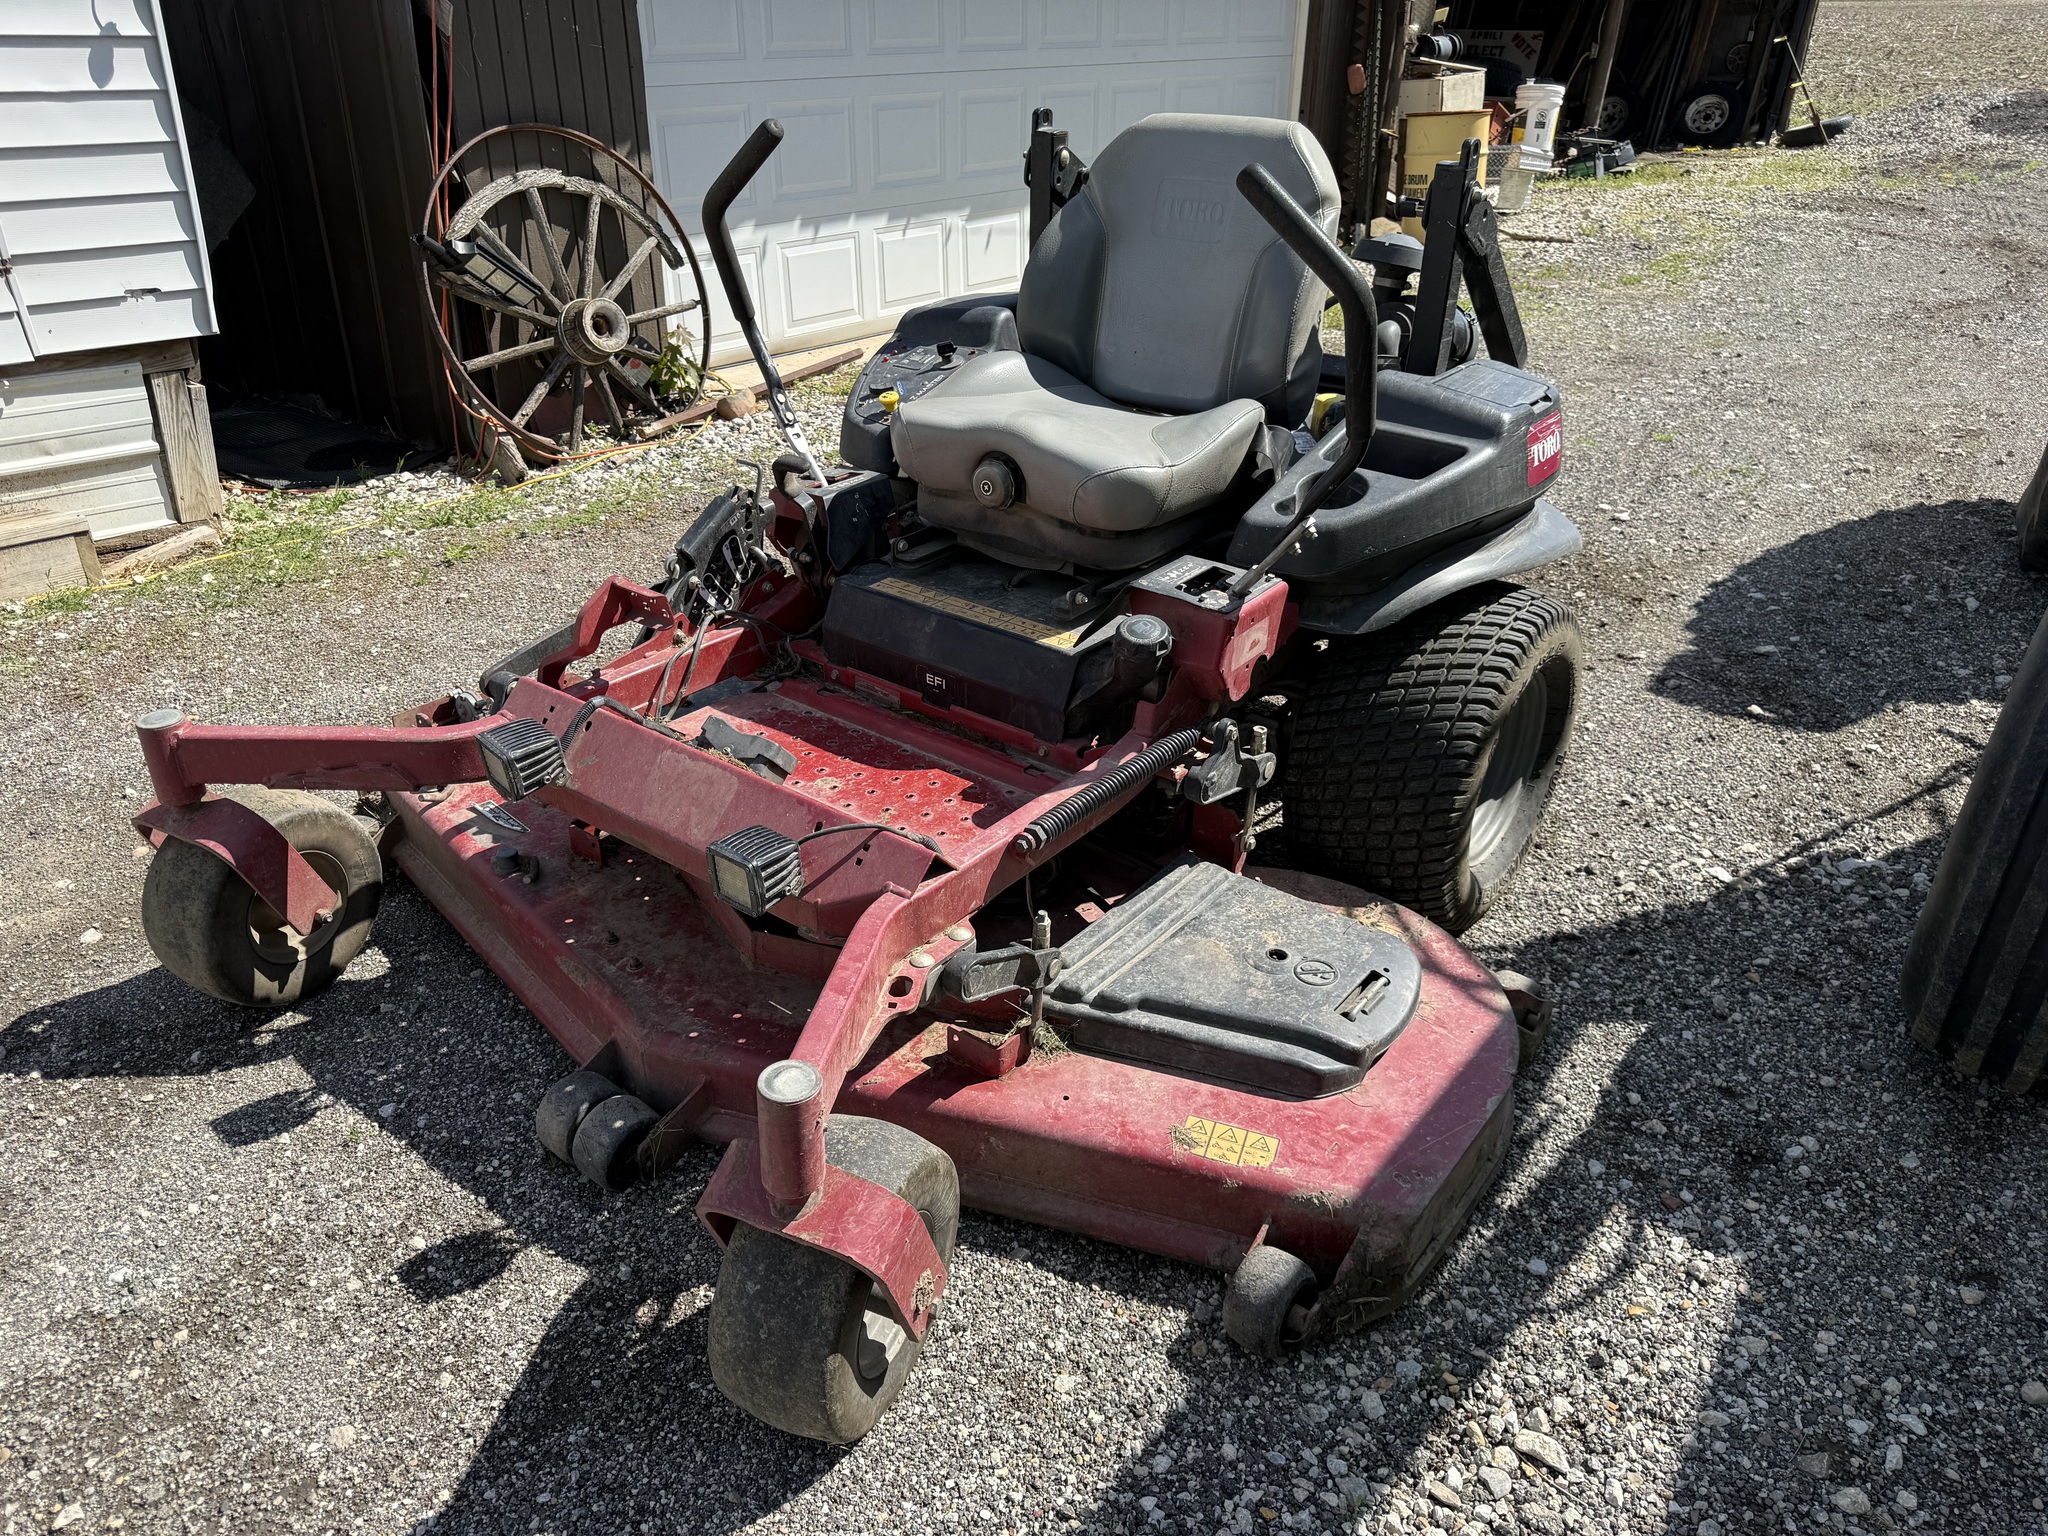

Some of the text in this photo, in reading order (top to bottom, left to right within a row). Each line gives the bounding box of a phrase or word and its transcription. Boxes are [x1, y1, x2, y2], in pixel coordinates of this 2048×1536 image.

[1466, 44, 1506, 57] ELECT
[1511, 32, 1537, 59] VOTE
[1408, 174, 1428, 185] DRUM
[1162, 198, 1225, 223] TORO
[1531, 430, 1561, 468] TORO
[926, 673, 946, 690] EFI
